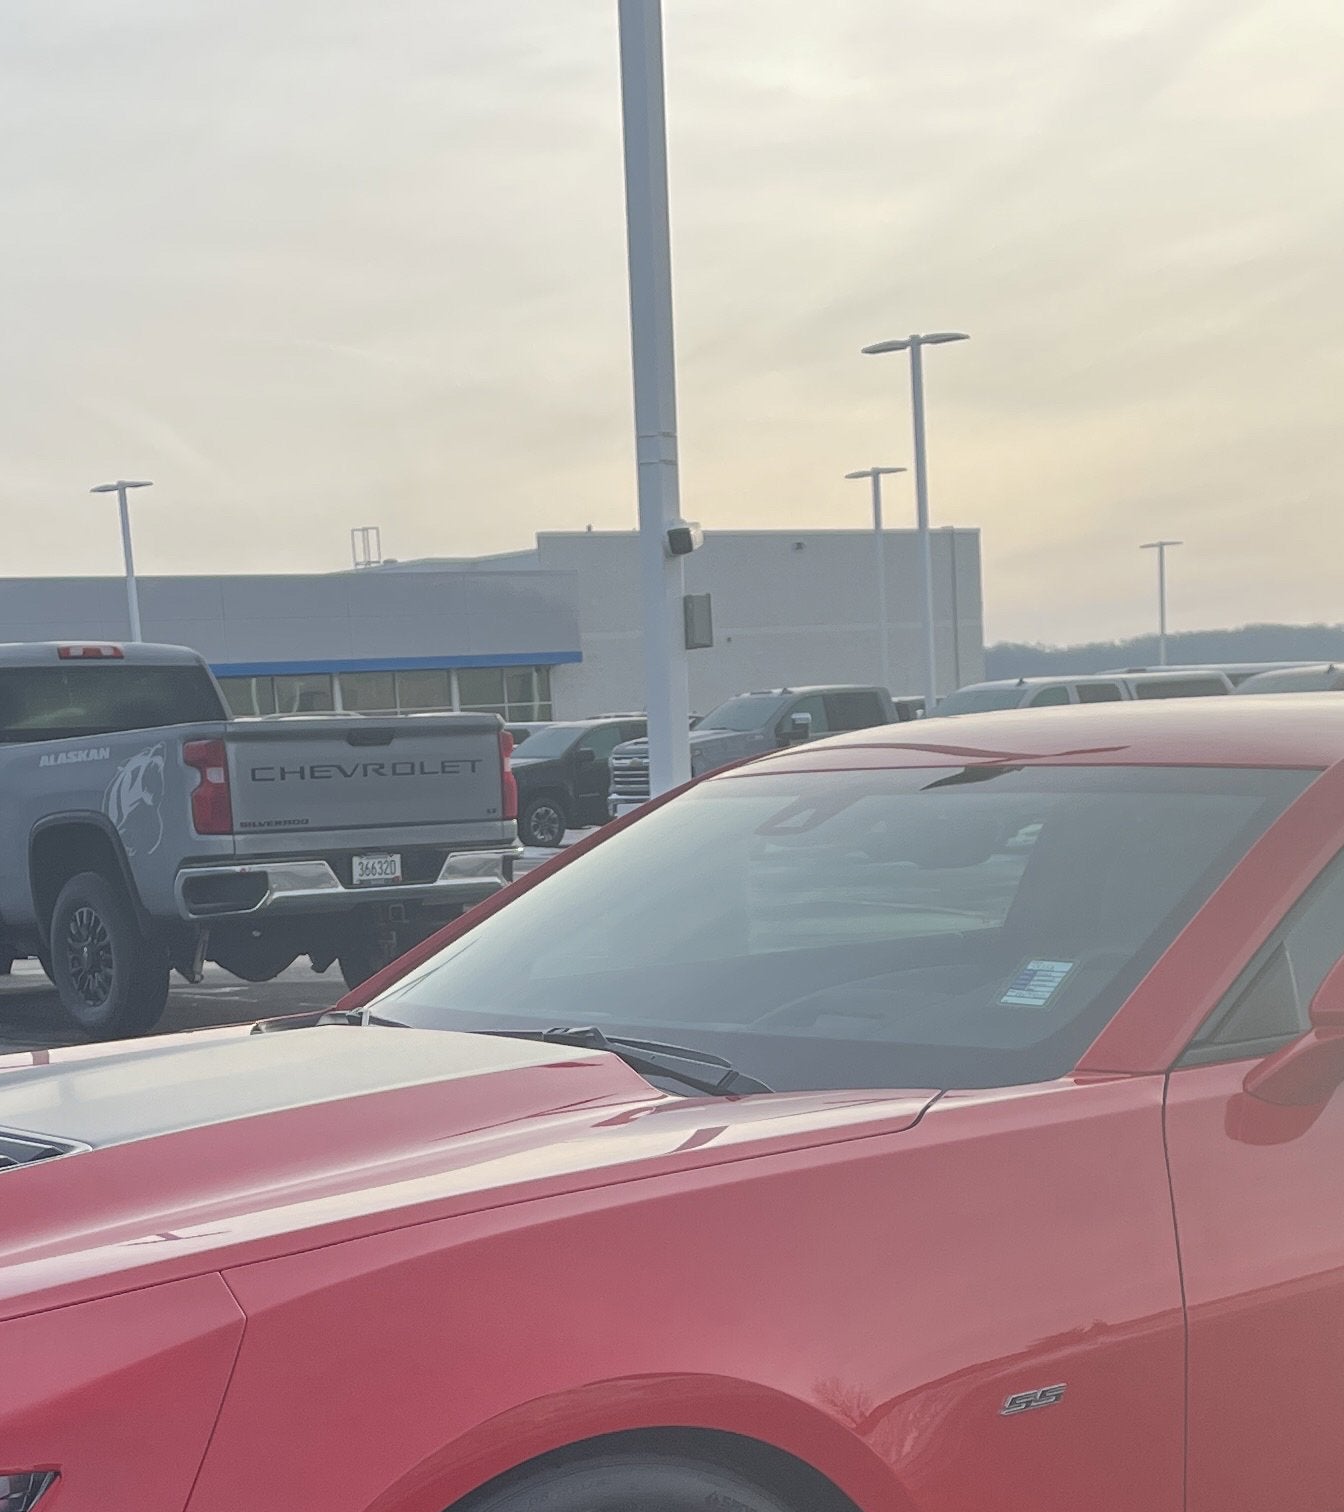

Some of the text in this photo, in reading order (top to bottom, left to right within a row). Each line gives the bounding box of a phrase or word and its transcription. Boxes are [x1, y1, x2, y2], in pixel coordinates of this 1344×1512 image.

[39, 747, 110, 767] ALASKAN
[251, 759, 483, 782] CHEVROLET
[358, 859, 396, 877] 366320
[1000, 1383, 1068, 1415] SS
